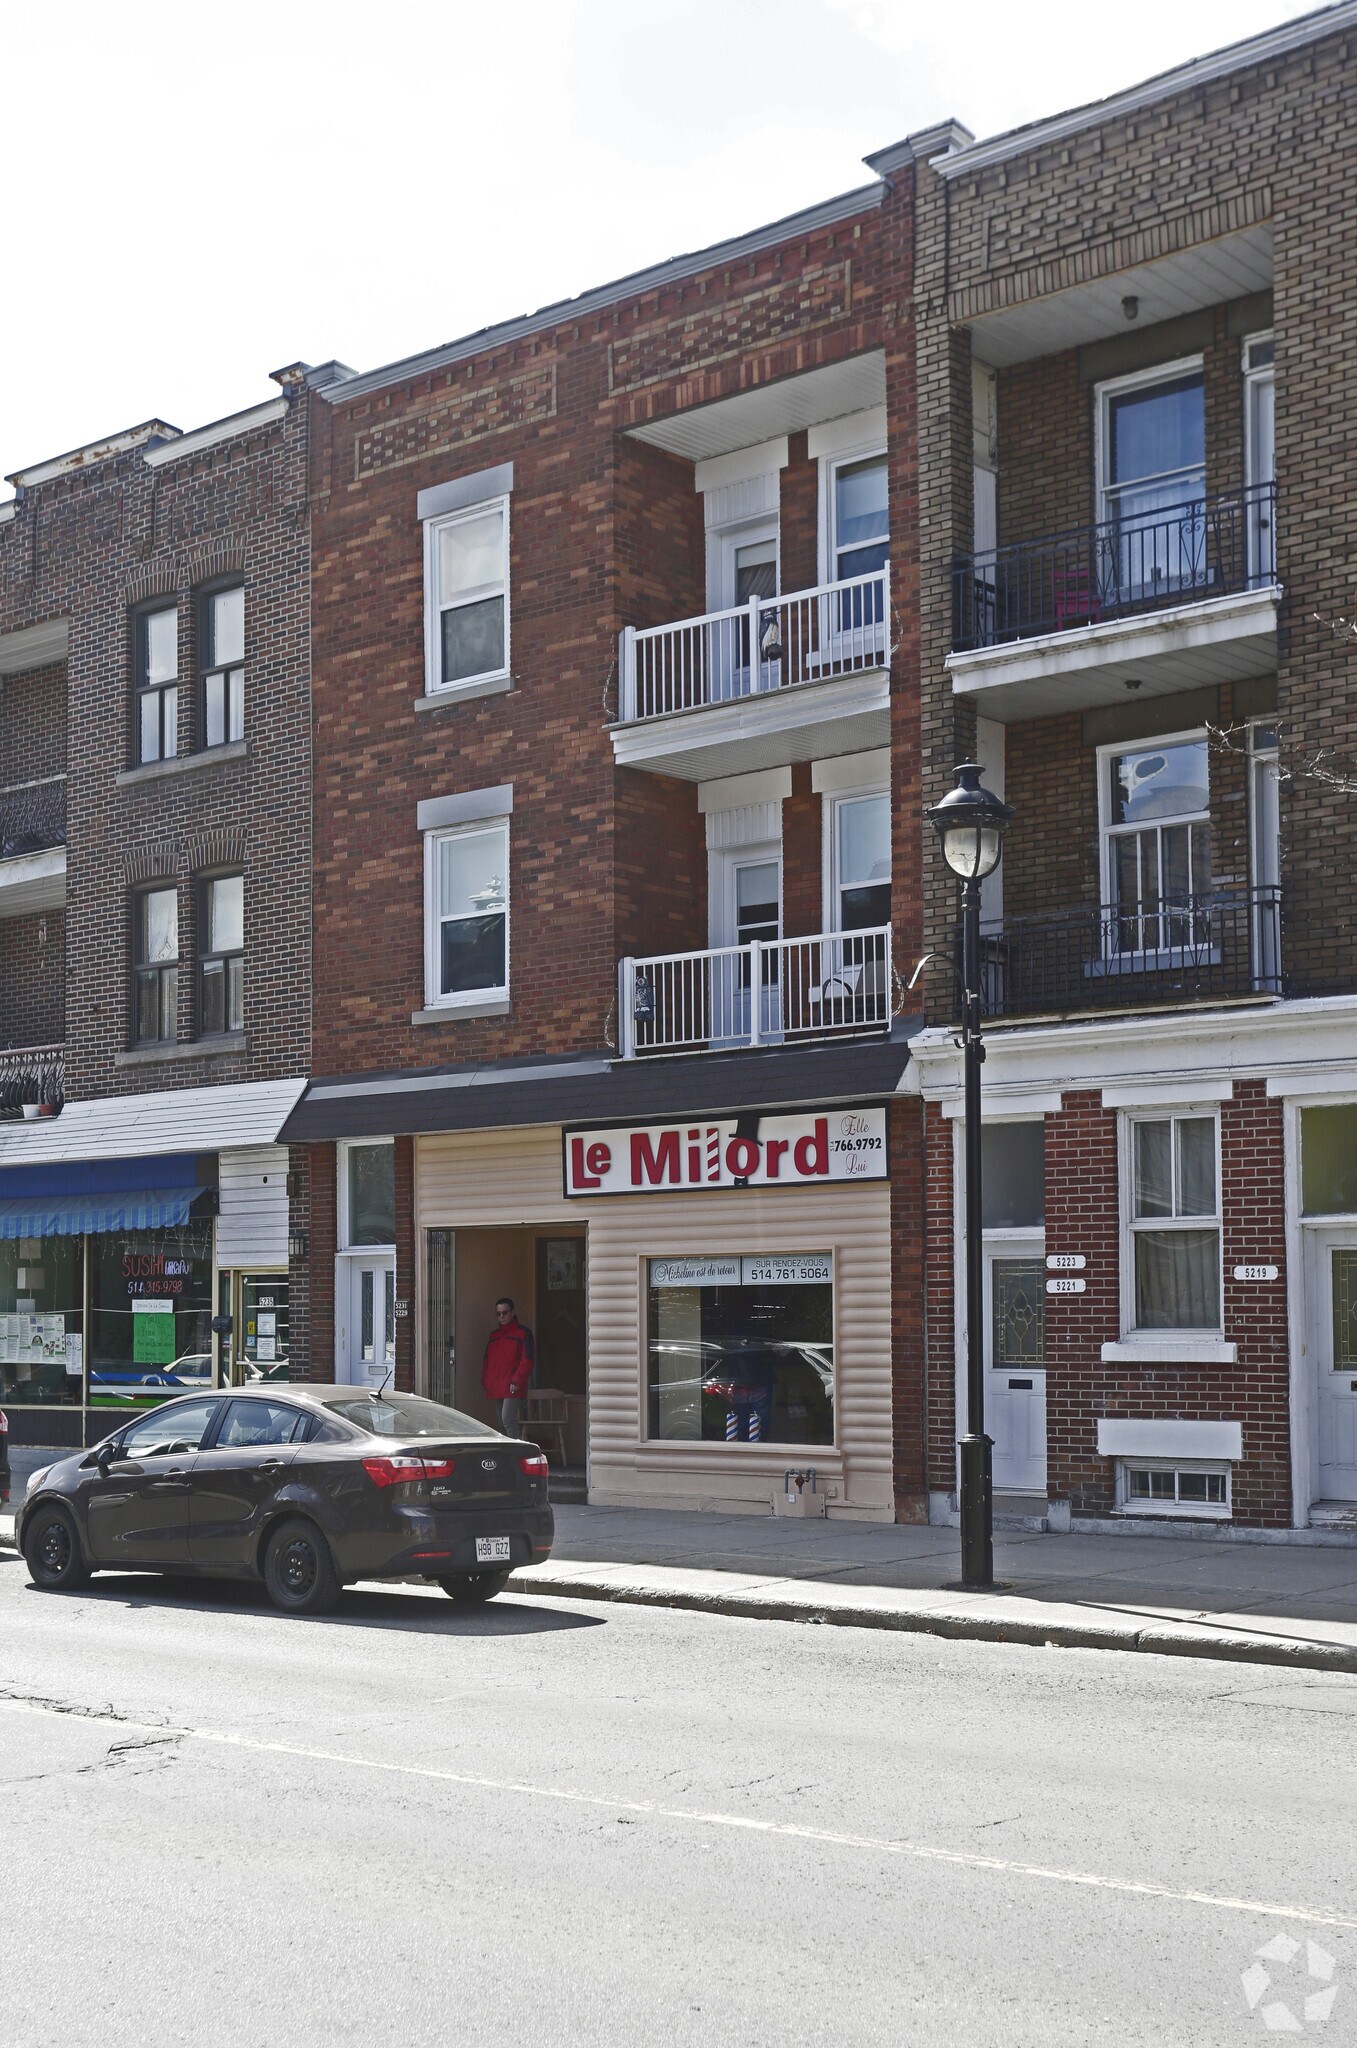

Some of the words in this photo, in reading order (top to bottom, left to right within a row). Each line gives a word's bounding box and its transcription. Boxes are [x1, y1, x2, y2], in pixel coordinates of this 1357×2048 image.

[841, 1115, 870, 1136] Elle
[835, 1138, 882, 1152] 766.9792
[571, 1137, 611, 1189] Le
[630, 1118, 829, 1185] Milord
[846, 1153, 867, 1174] Lui
[122, 1254, 164, 1277] SUSHI
[756, 1260, 770, 1268] SUR
[773, 1258, 824, 1267] RENDEZ-VOUS
[1056, 1257, 1076, 1267] 5223
[751, 1268, 829, 1280] 514.761.5064
[1245, 1268, 1267, 1278] 5219
[1056, 1281, 1076, 1291] 5221
